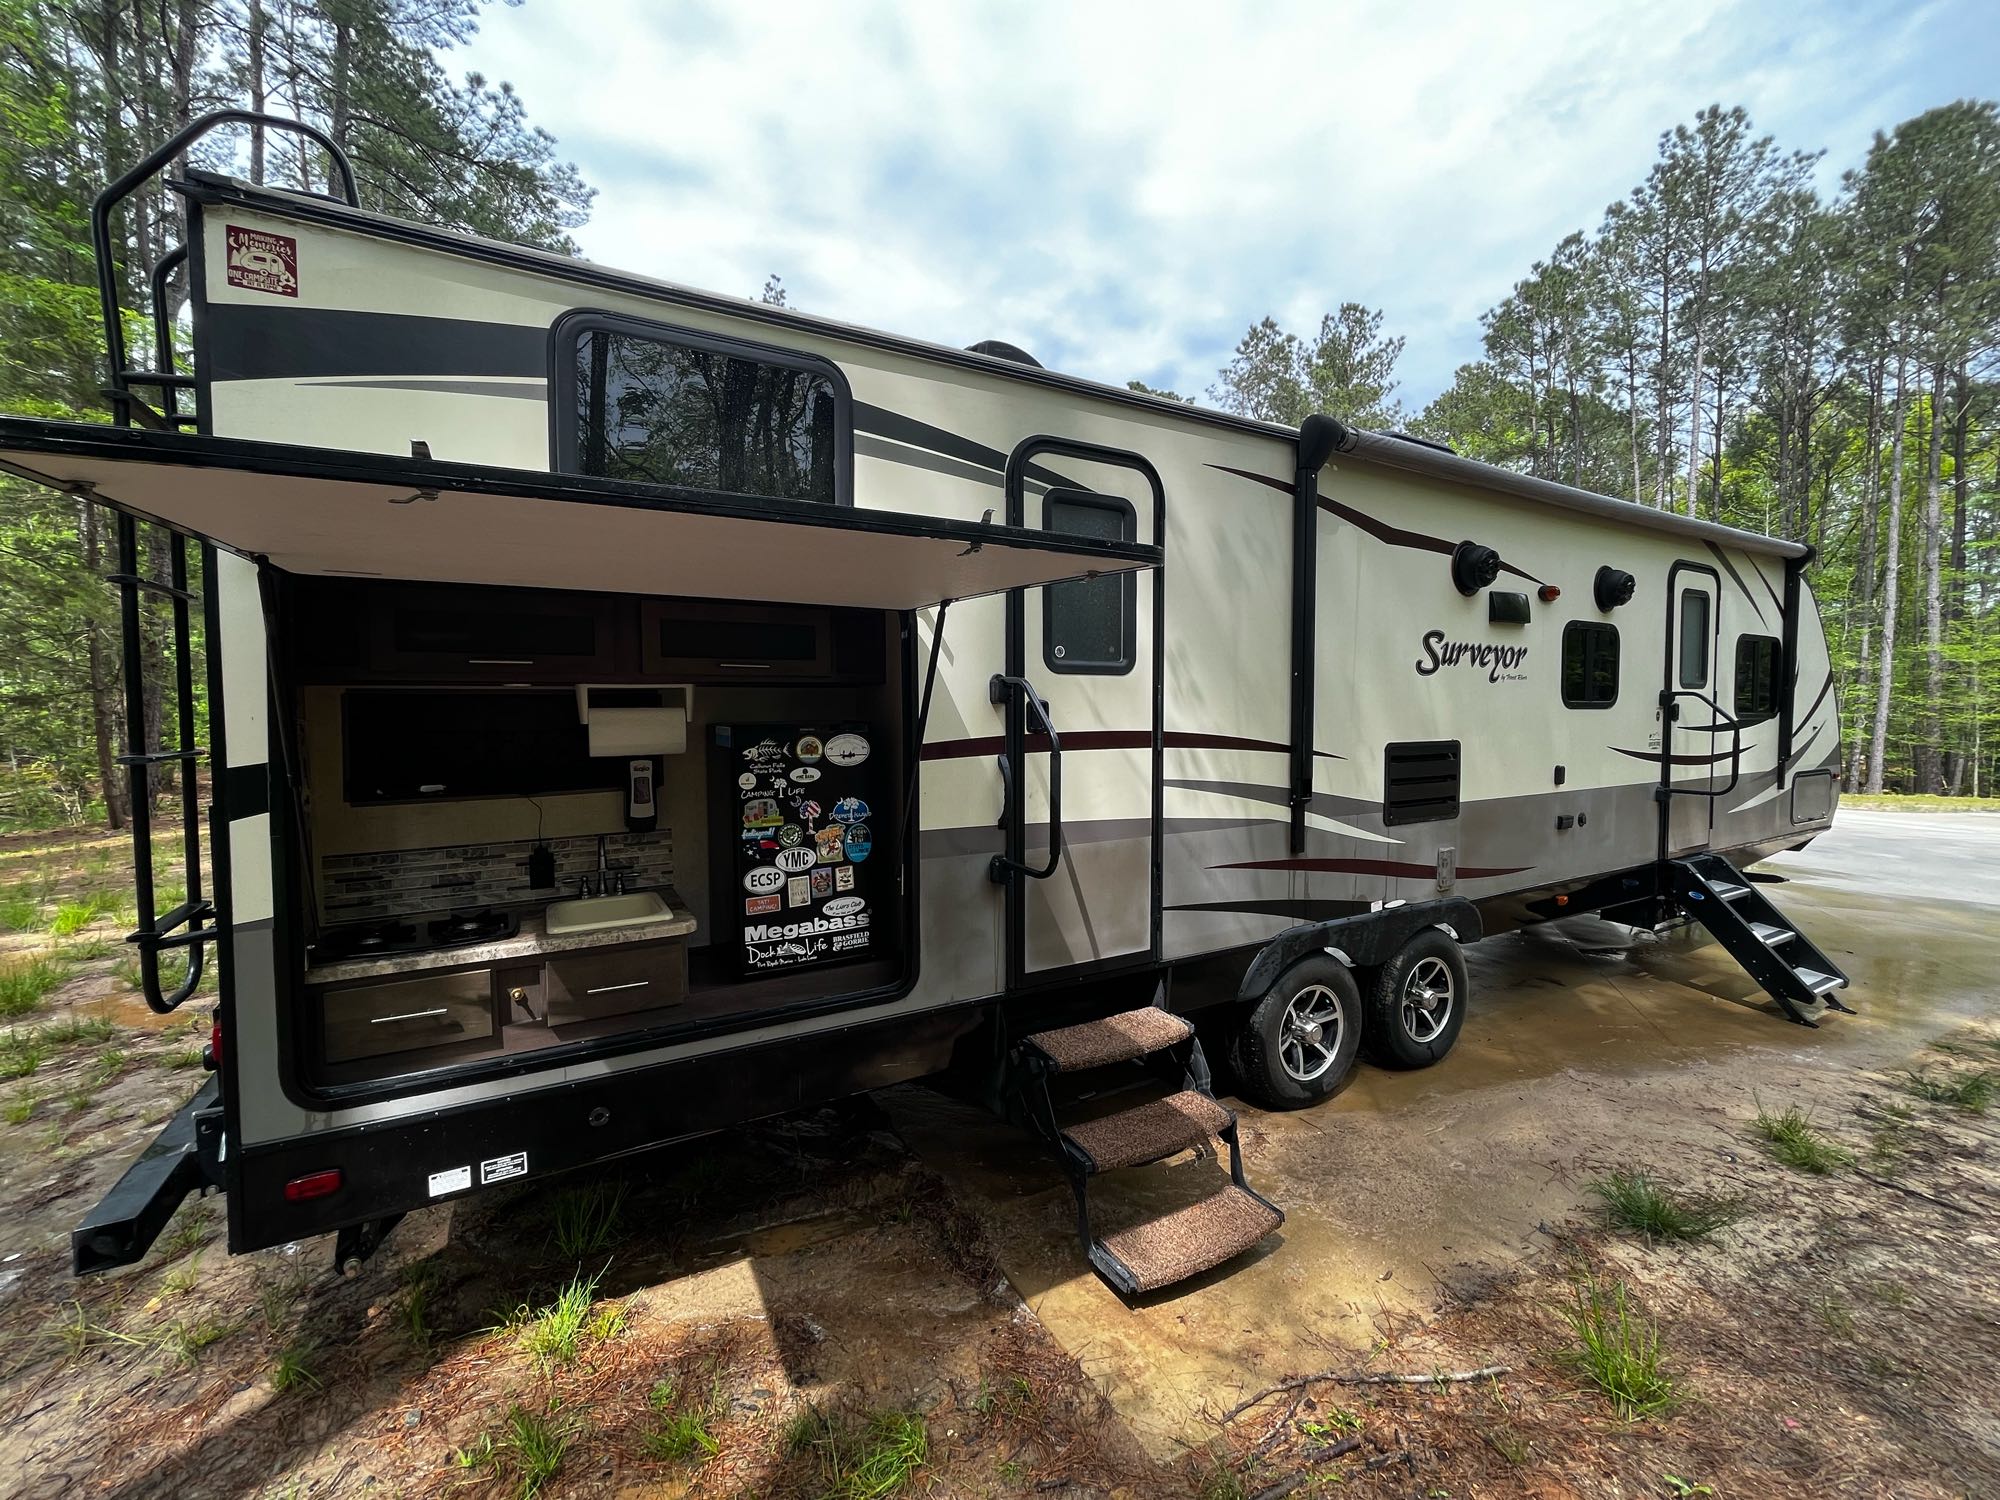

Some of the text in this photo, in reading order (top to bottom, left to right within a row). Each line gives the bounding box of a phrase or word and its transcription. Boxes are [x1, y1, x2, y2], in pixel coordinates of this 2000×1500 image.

[238, 232, 291, 256] Memories
[250, 233, 277, 245] MAKING
[228, 268, 243, 280] ONE
[1415, 629, 1528, 684] Surveyor
[741, 787, 805, 799] CAMPING LIFE
[783, 851, 809, 868] YMC
[750, 871, 781, 888] ECSP
[744, 912, 870, 942] Megabass
[832, 931, 870, 943] BRASFIELD
[832, 942, 843, 952] &
[842, 936, 870, 947] GORRIE
[746, 938, 829, 964] Dock Life
